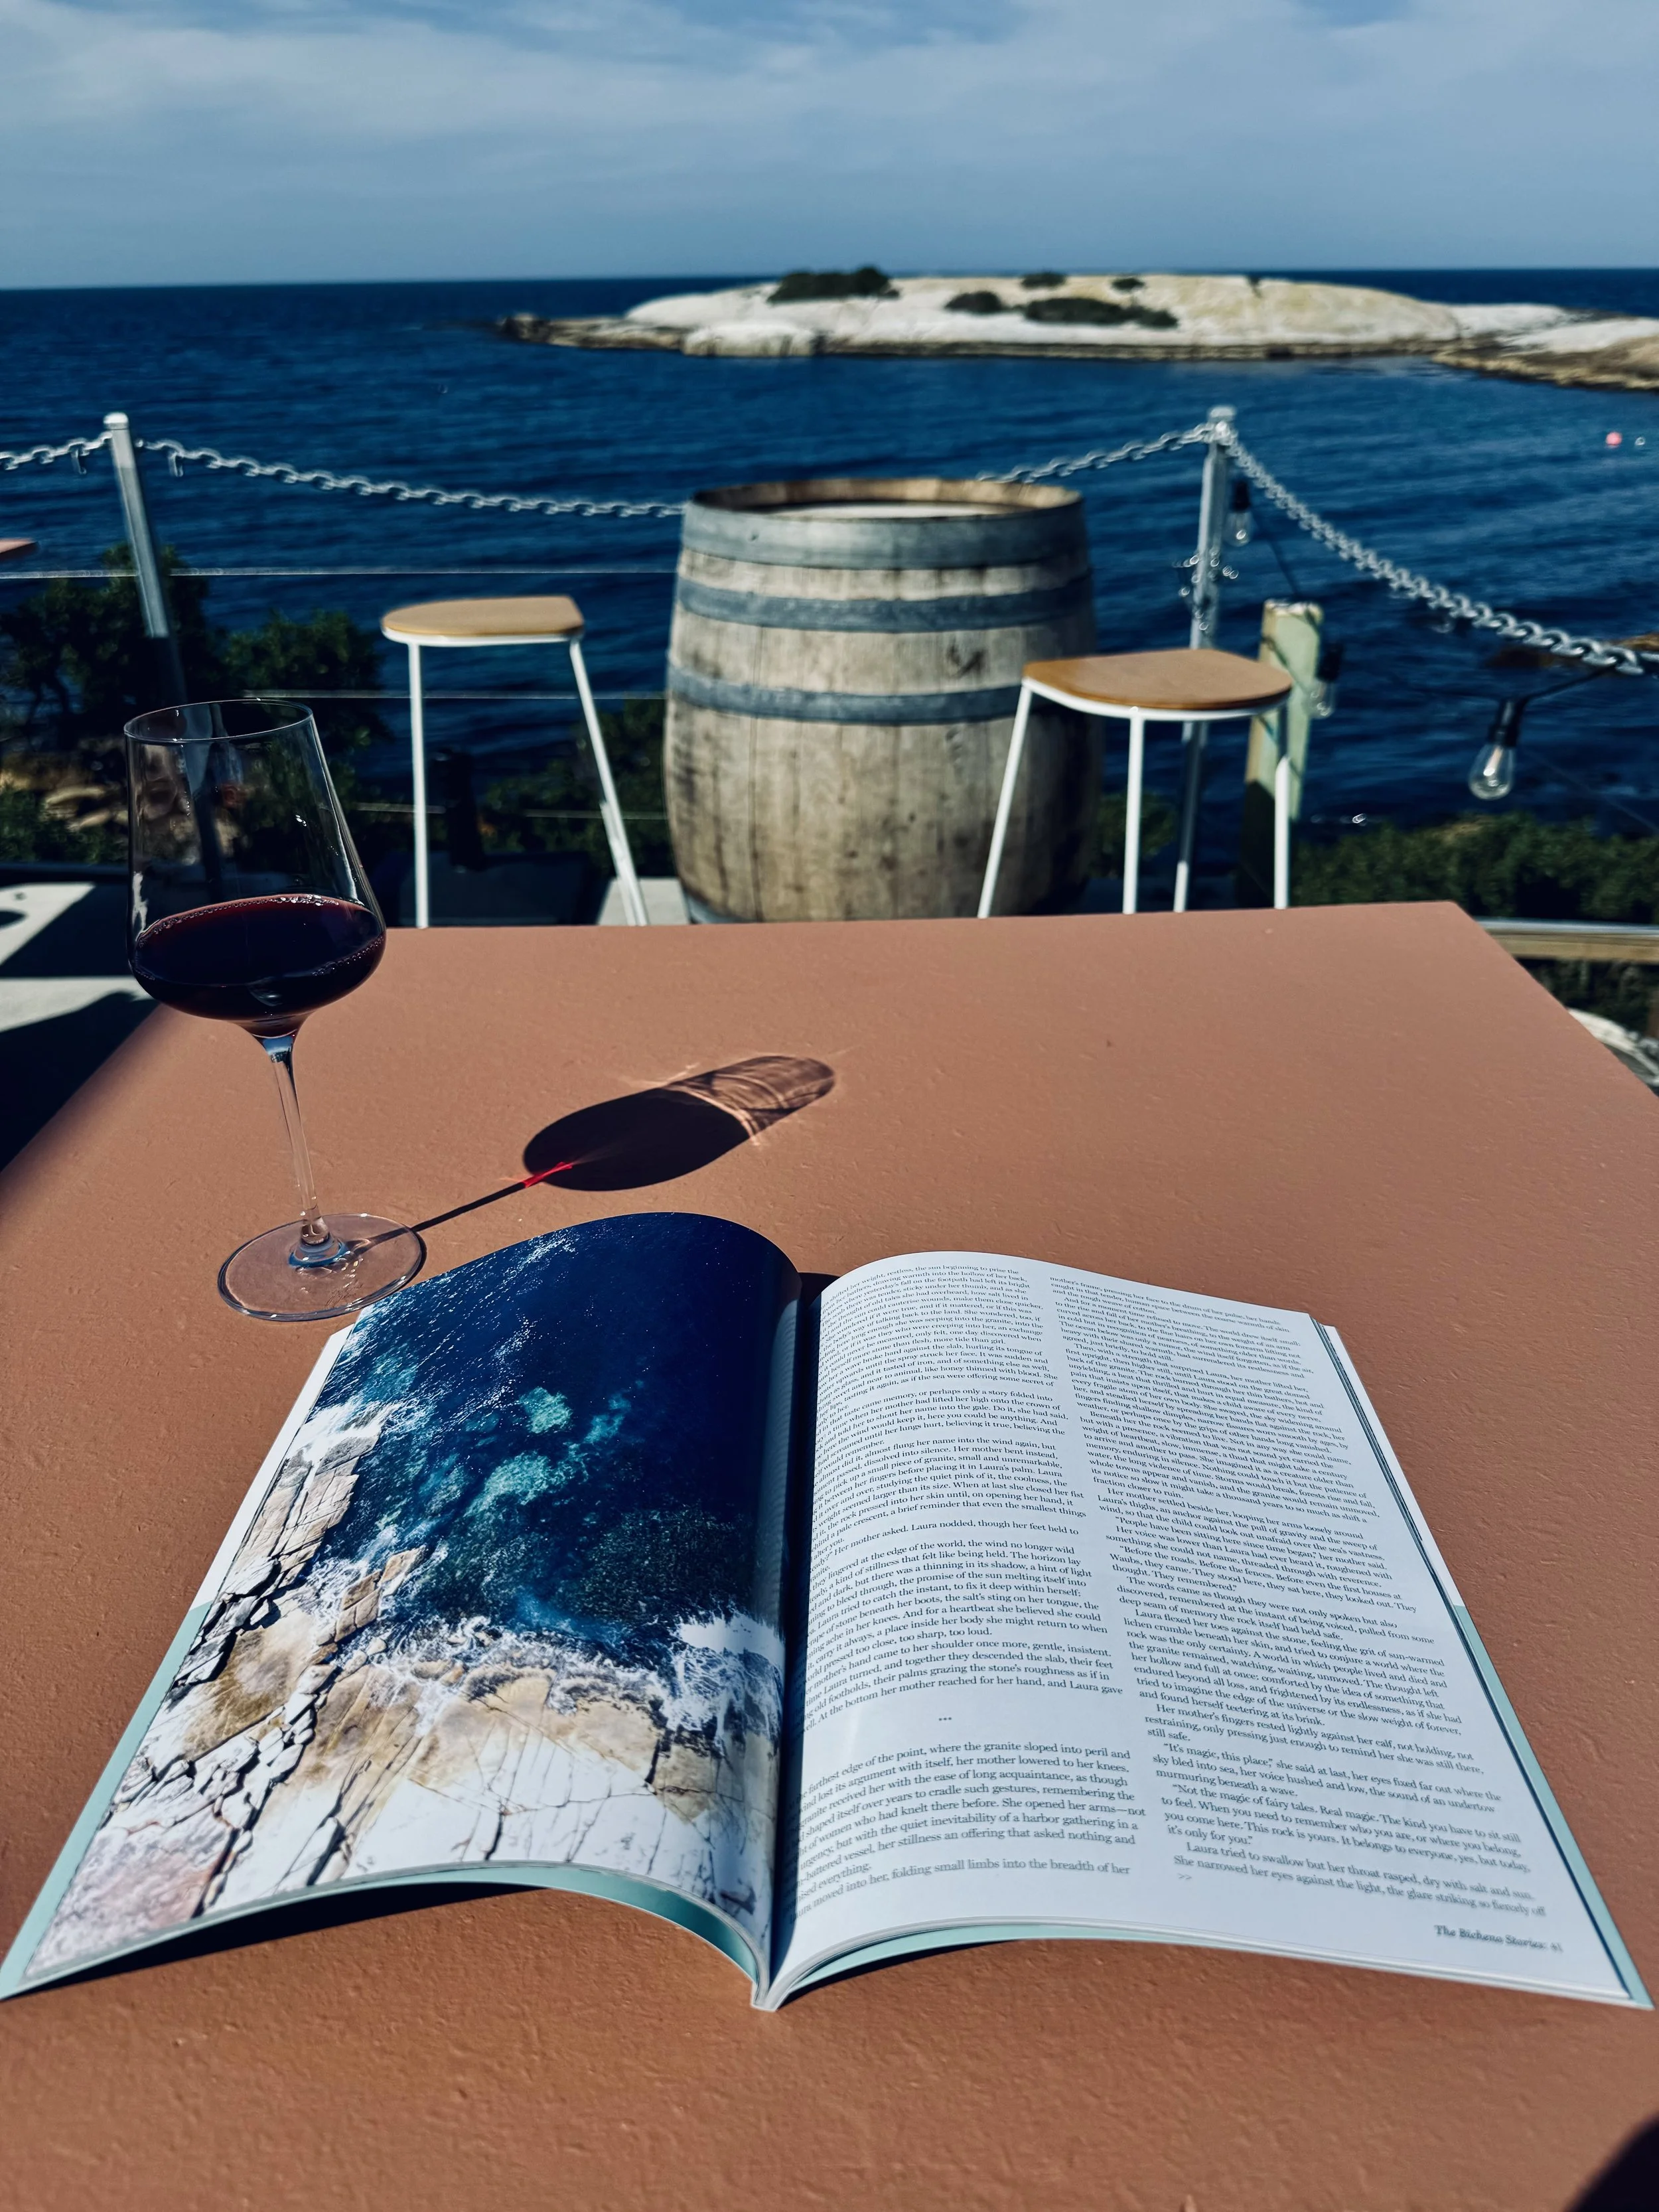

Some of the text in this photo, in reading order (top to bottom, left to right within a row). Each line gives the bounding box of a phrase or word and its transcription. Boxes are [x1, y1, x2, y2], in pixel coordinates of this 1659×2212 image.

[1139, 1349, 1157, 1359] hold
[830, 1414, 842, 1426] that
[843, 1406, 861, 1417] taste
[861, 1400, 881, 1410] came
[928, 1388, 961, 1396] perhaps
[1009, 1390, 1035, 1399] folded
[1093, 1475, 1125, 1488] fraction
[1127, 1482, 1151, 1493] closer
[834, 1544, 849, 1556] Her
[850, 1532, 881, 1548] mother
[881, 1524, 908, 1537] asked.
[939, 1519, 976, 1528] nodded,
[977, 1519, 1011, 1528] though
[1012, 1520, 1028, 1529] her
[1029, 1522, 1046, 1531] feet
[1047, 1524, 1068, 1534] held
[812, 1577, 827, 1591] they
[828, 1558, 859, 1580] lingered
[871, 1552, 885, 1560] the
[886, 1546, 907, 1556] edge
[908, 1543, 920, 1552] of
[920, 1542, 935, 1550] the
[936, 1539, 966, 1548] world,
[1024, 1541, 1053, 1552] longer
[1054, 1546, 1075, 1554] wild
[1151, 1570, 1175, 1582] They
[824, 1648, 853, 1672] pressed
[855, 1645, 870, 1655] too
[871, 1639, 897, 1649] close,
[916, 1630, 947, 1639] sharp,
[967, 1626, 992, 1635] loud.
[1135, 1608, 1163, 1620] Laura
[1163, 1613, 1192, 1625] flexed
[1192, 1617, 1208, 1628] her
[1210, 1622, 1230, 1631] toes
[1230, 1627, 1264, 1638] against
[1264, 1631, 1280, 1641] the
[1281, 1635, 1309, 1646] stone,
[1310, 1638, 1342, 1652] feeling
[1342, 1643, 1358, 1653] the
[1358, 1647, 1376, 1656] grit
[1388, 1653, 1445, 1666] sun-warmed
[818, 1675, 1123, 1723] At the bottom her mother reached for her hand, and Laura gave
[1139, 1690, 1158, 1699] and
[1159, 1691, 1190, 1704] found
[1190, 1696, 1224, 1710] herself
[1225, 1703, 1269, 1719] teetering
[1281, 1711, 1295, 1721] its
[1295, 1713, 1325, 1726] brink.
[1147, 1728, 1191, 1741] still safe.
[808, 1741, 1131, 1792] farthest edge of the point, where the granite sloped into peril and
[1155, 1769, 1217, 1787] murmuring
[1216, 1775, 1259, 1791] beneath
[1268, 1786, 1298, 1797] wave.
[1186, 1747, 1220, 1760] magic,
[1220, 1750, 1241, 1762] this
[1275, 1759, 1293, 1770] she
[1295, 1763, 1316, 1774] said
[1328, 1767, 1351, 1780] last,
[1350, 1770, 1368, 1781] her
[1370, 1776, 1392, 1786] eyes
[1392, 1777, 1417, 1789] fixed
[1418, 1781, 1433, 1791] far
[1434, 1785, 1453, 1794] out
[1453, 1786, 1483, 1799] where
[1484, 1791, 1501, 1801] the
[1184, 1827, 1208, 1841] only
[1209, 1830, 1226, 1842] for
[813, 1883, 843, 1907] moved
[846, 1879, 867, 1892] into
[891, 1865, 932, 1880] folding
[934, 1859, 966, 1872] small
[967, 1858, 1000, 1870] limbs
[1002, 1858, 1027, 1869] into
[1028, 1858, 1048, 1869] the
[1049, 1858, 1095, 1872] breadth
[1096, 1862, 1110, 1873] of
[1110, 1862, 1130, 1874] her
[1435, 1924, 1457, 1938] The
